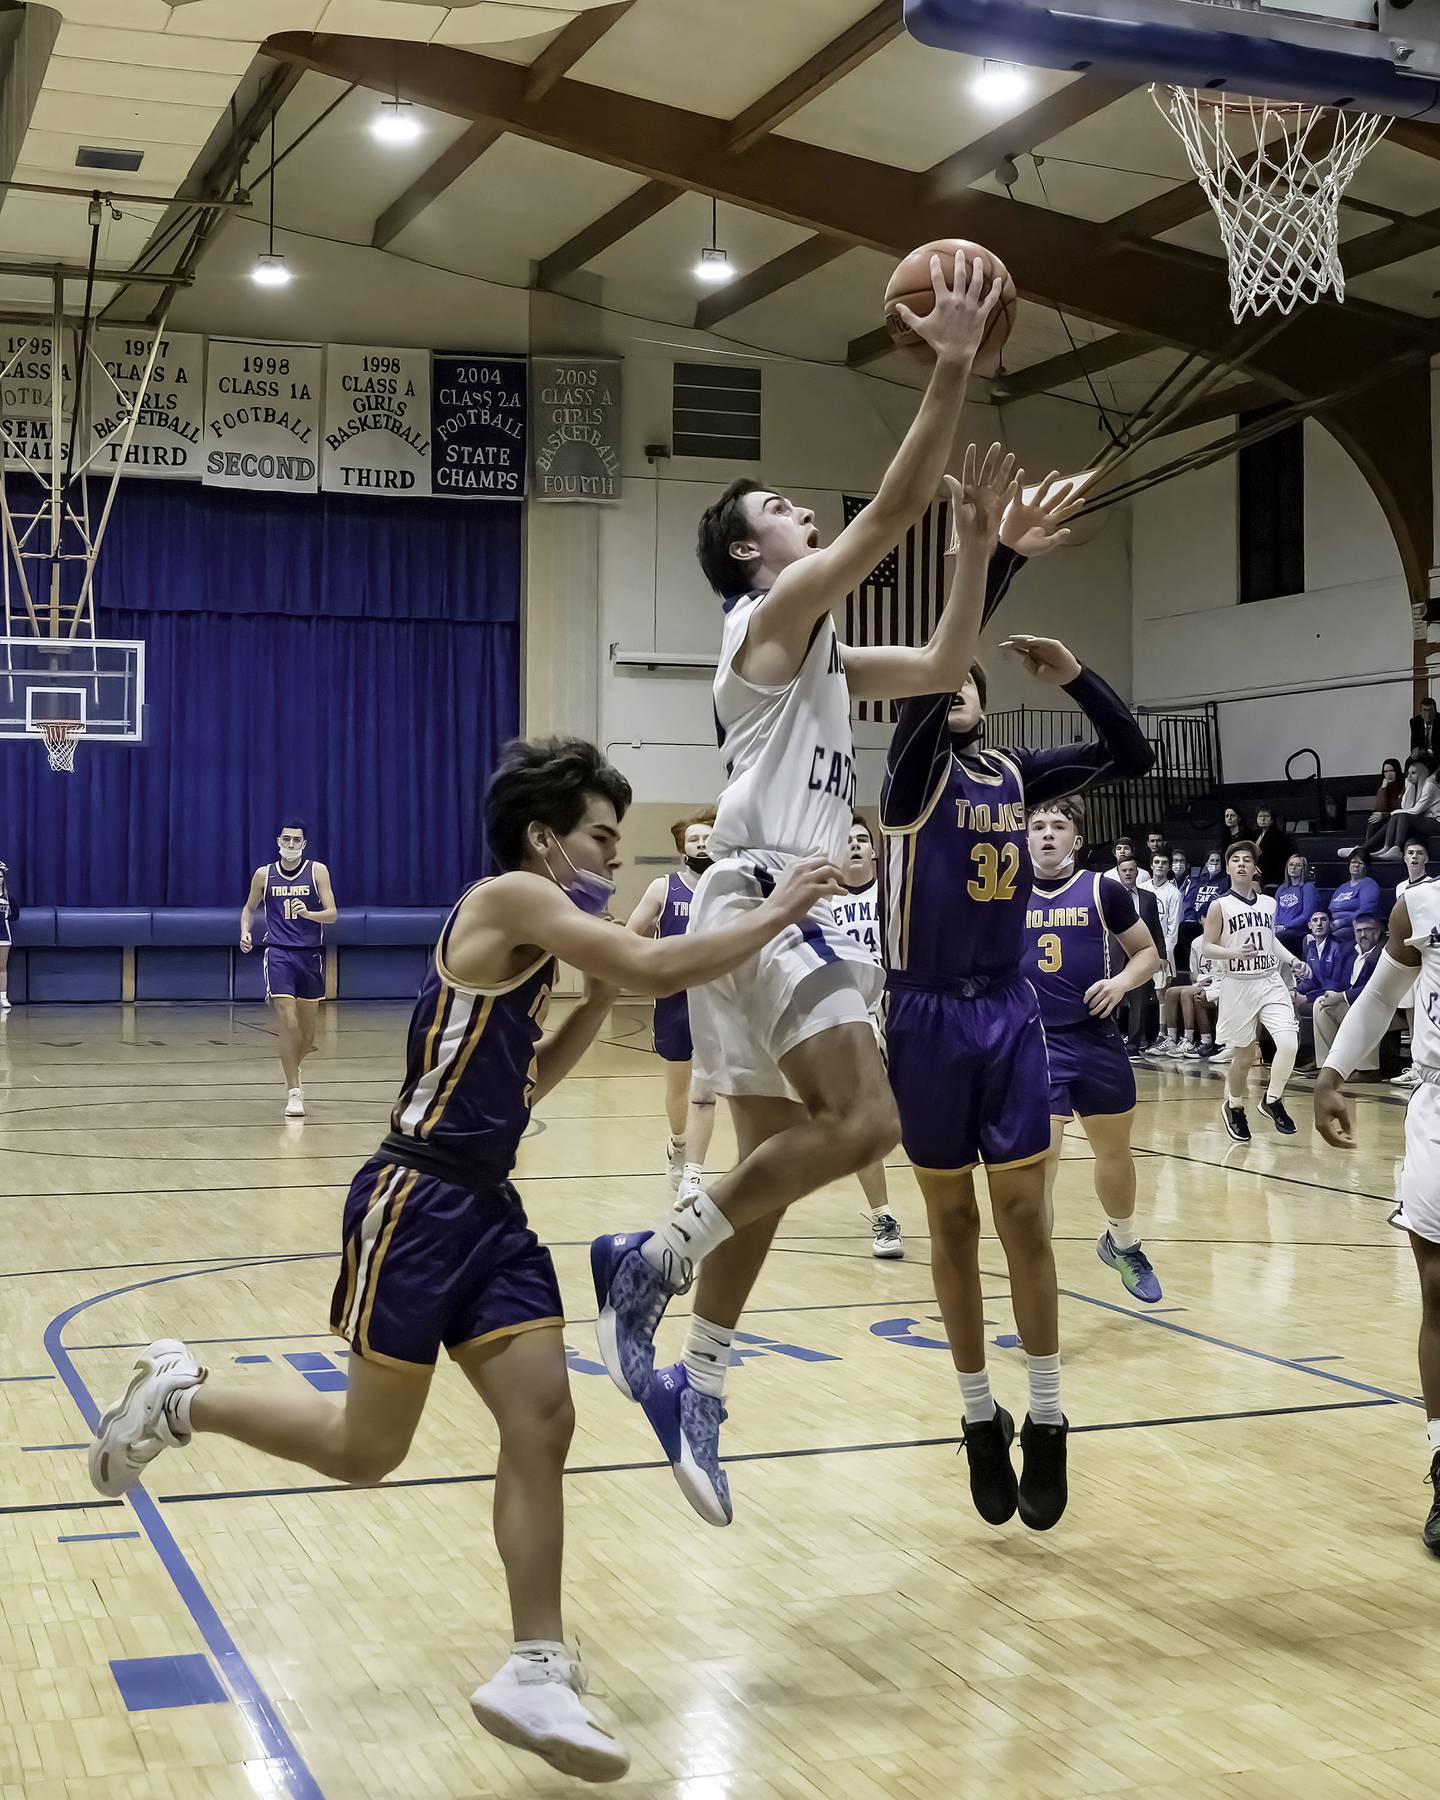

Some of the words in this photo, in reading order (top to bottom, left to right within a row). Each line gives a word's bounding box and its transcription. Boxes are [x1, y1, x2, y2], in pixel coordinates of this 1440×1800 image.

[7, 337, 52, 356] 1995
[175, 367, 188, 383] A
[243, 356, 290, 375] 1998
[362, 355, 401, 374] 1998
[342, 375, 398, 395] CLASS
[405, 380, 416, 397] A
[456, 367, 502, 385] 2004
[218, 376, 279, 397] CLASS
[289, 383, 312, 400] 1A
[439, 388, 493, 408] CLASS
[497, 391, 521, 407] 2A
[541, 388, 596, 405] CLASS
[601, 389, 613, 406] A
[352, 394, 408, 417] GIRLS
[552, 408, 603, 425] GIRLS
[2, 420, 53, 440] SEM
[209, 406, 312, 445] FOOTBALL
[325, 413, 430, 457] BASKETBALL
[436, 409, 523, 441] FOOTBALL
[105, 443, 187, 466] THIRD
[446, 444, 511, 466] STATE
[536, 425, 620, 476] BASKETBALL
[206, 450, 316, 481] SECOND
[340, 466, 416, 489] THIRD
[436, 466, 518, 490] CHAMPS
[543, 475, 616, 495] FOURTH
[967, 841, 1020, 902] 32
[1037, 933, 1063, 973] 3
